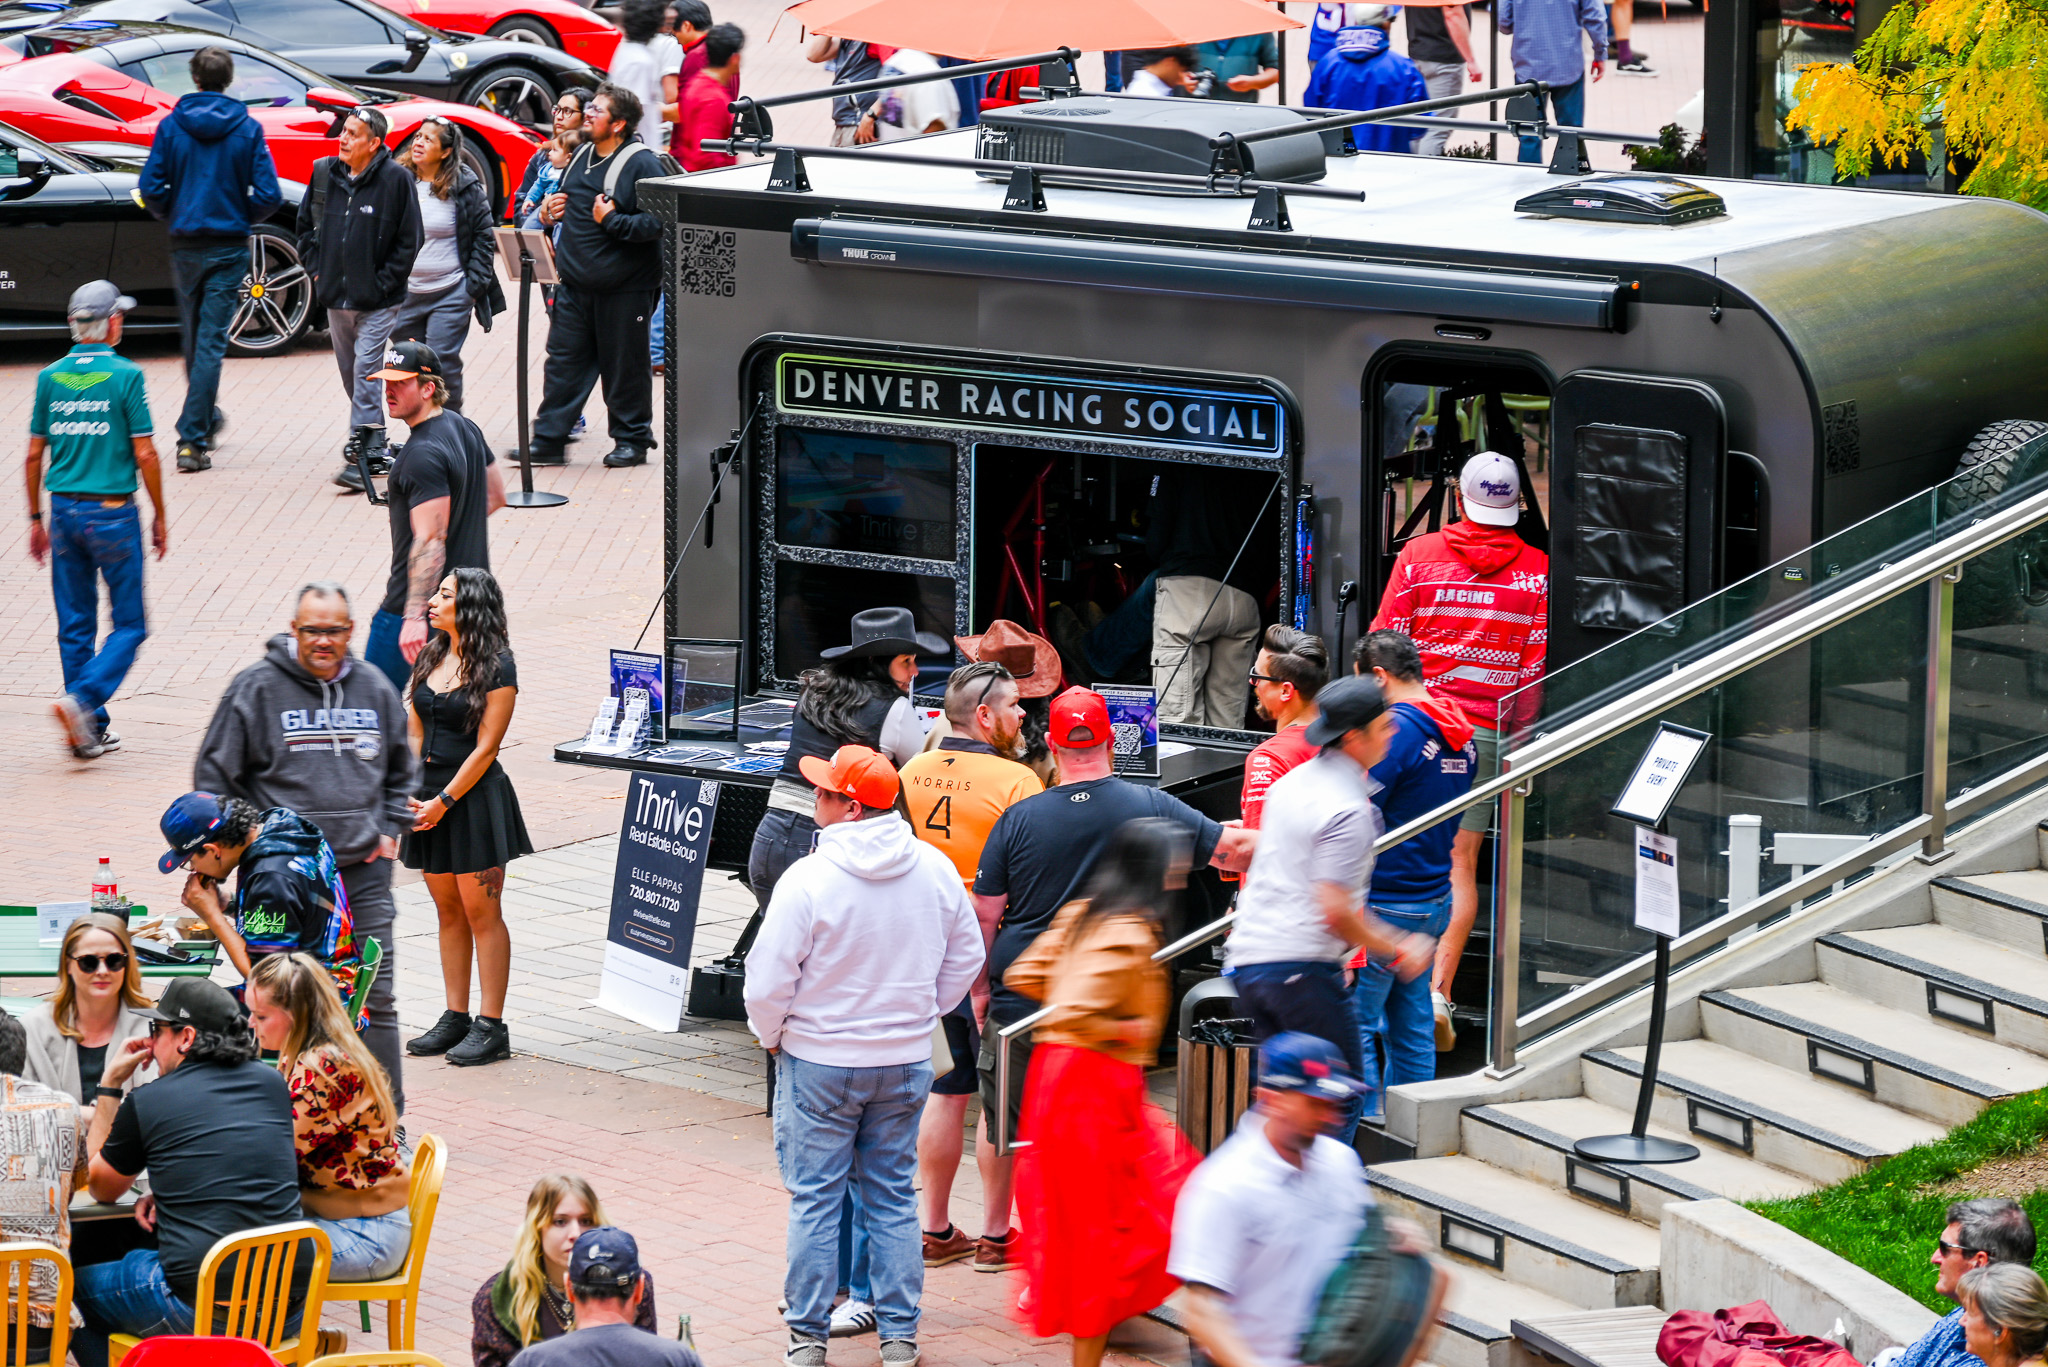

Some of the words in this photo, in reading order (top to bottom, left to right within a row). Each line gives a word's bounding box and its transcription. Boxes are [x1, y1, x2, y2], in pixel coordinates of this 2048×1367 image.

[698, 256, 718, 269] DRS
[842, 247, 869, 259] THULE
[794, 368, 940, 411] DENVER
[960, 382, 1102, 425] RACING
[1124, 398, 1266, 440] SOCIAL
[49, 420, 111, 436] aramco
[1434, 588, 1496, 605] RACING
[280, 708, 379, 731] GLACIER
[1653, 757, 1679, 773] PRIVATE
[912, 775, 971, 792] NORRIS
[1646, 773, 1668, 787] EVENT
[635, 778, 703, 842] Thrive
[925, 795, 952, 840] 4
[629, 825, 648, 845] Real
[646, 831, 672, 853] Estate
[671, 841, 697, 864] Group
[631, 866, 650, 883] ELLE
[651, 874, 684, 894] PAPPAS
[629, 884, 680, 913] 720.807.1720
[633, 908, 671, 929] thrivewithelle.com
